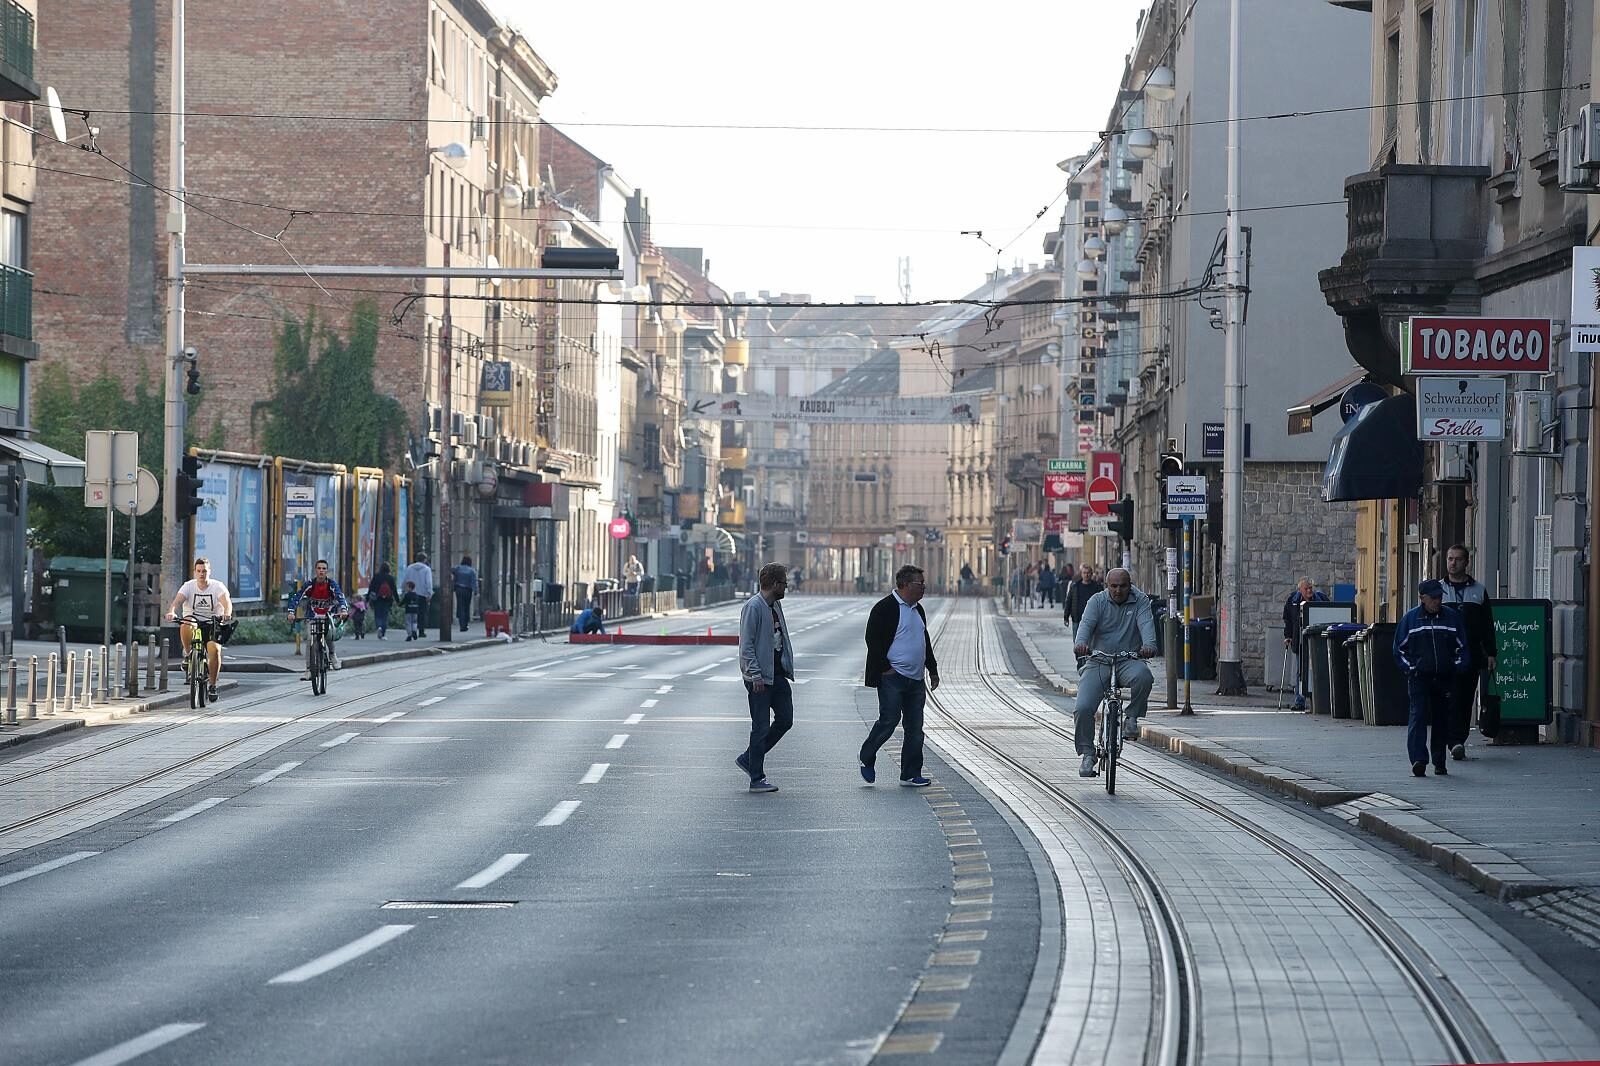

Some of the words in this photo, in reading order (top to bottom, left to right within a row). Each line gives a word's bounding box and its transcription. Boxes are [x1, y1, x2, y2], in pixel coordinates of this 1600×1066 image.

[1420, 328, 1543, 361] TOBACCO
[1424, 392, 1499, 407] Schwarzkopf
[799, 400, 836, 413] KAUBOJI
[1430, 419, 1484, 436] Stella
[1050, 460, 1083, 470] LJEKARNA
[1508, 620, 1540, 634] Zagreb
[1502, 639, 1511, 650] je
[1522, 656, 1530, 667] je
[1495, 671, 1514, 685] ljepši
[1516, 672, 1537, 682] kada
[1503, 690, 1511, 702] je
[1512, 689, 1529, 699] čist.
